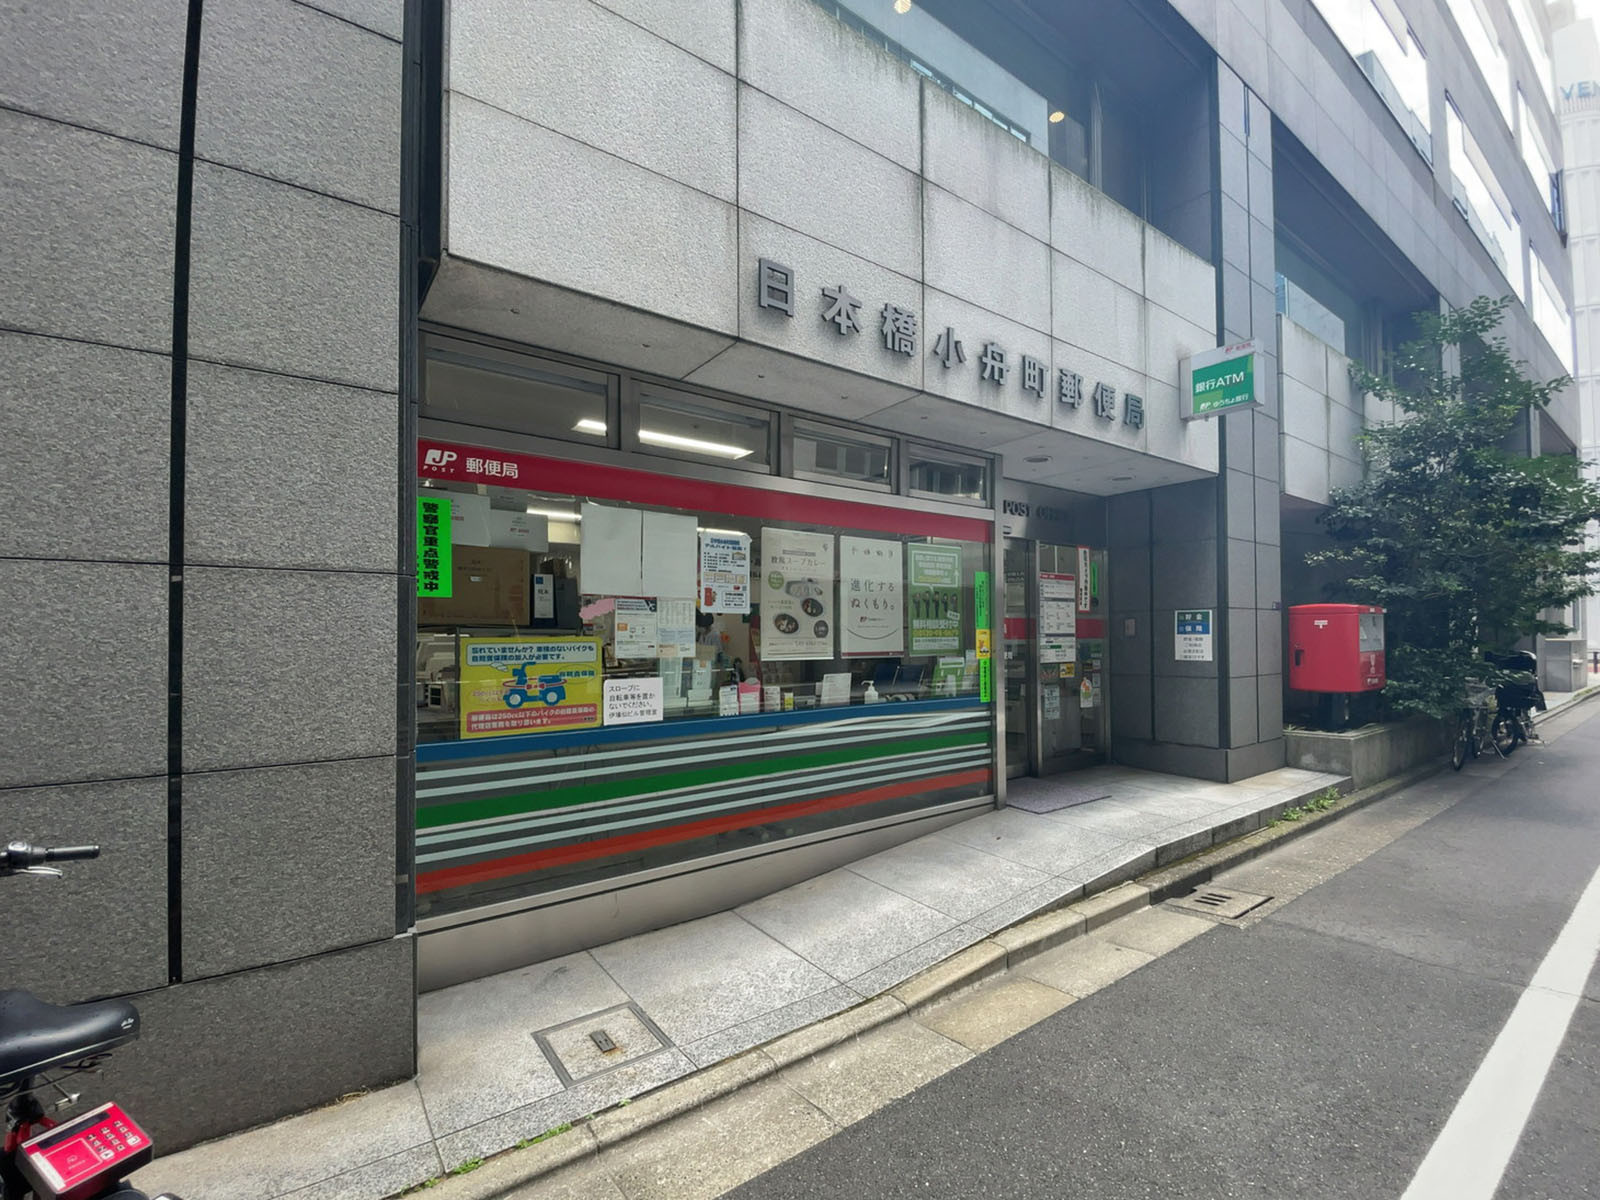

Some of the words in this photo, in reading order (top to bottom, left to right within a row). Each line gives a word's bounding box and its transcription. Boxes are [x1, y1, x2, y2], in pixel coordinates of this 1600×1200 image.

[758, 258, 1145, 429] 日本橋小舟町郵便局
[1195, 371, 1244, 393] 銀行ATM
[1213, 393, 1249, 408] ゆうちょ銀行
[423, 465, 454, 473] POST
[466, 457, 519, 479] 郵便局
[1003, 500, 1031, 517] POST
[422, 502, 439, 592] 警察官重点警戒中
[851, 579, 894, 592] 進化する
[851, 598, 894, 610] ぬくもり。
[609, 684, 640, 692] スロープに
